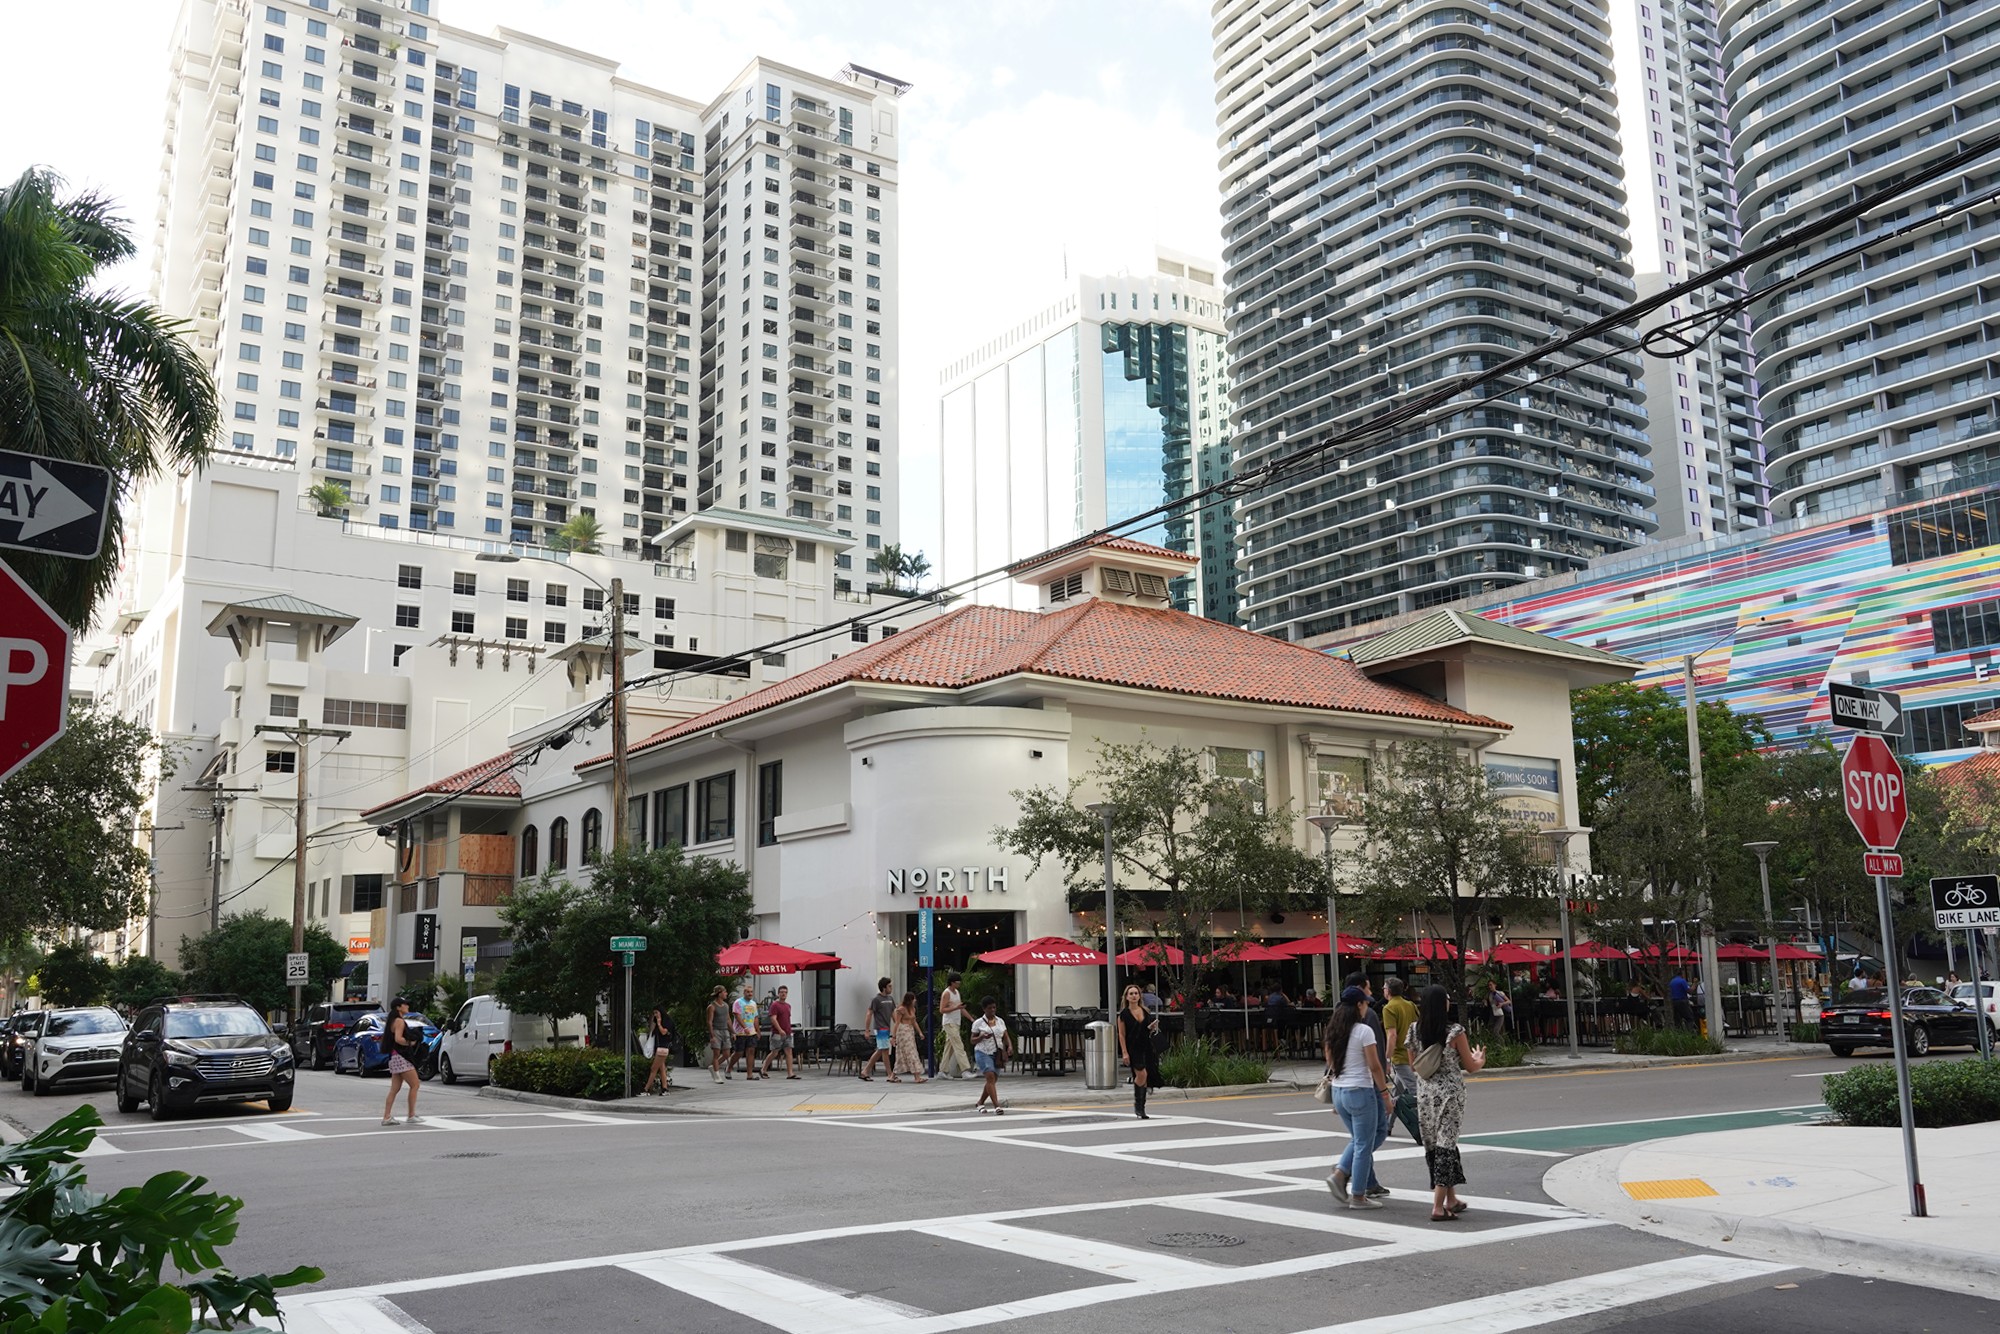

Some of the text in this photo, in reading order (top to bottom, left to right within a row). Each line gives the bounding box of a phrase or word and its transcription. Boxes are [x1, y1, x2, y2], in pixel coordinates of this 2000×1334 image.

[1837, 696, 1880, 719] ONE WAY
[1527, 774, 1548, 785] SOON
[1848, 769, 1900, 813] STOP
[1869, 858, 1898, 872] ALL WAY
[887, 866, 1009, 895] NORTH
[919, 895, 969, 909] ITALIA
[1938, 910, 1999, 924] BIKE LANE
[423, 917, 431, 949] NORTH
[1030, 951, 1096, 959] NORTH
[289, 966, 306, 977] 25
[758, 965, 787, 974] NORTH
